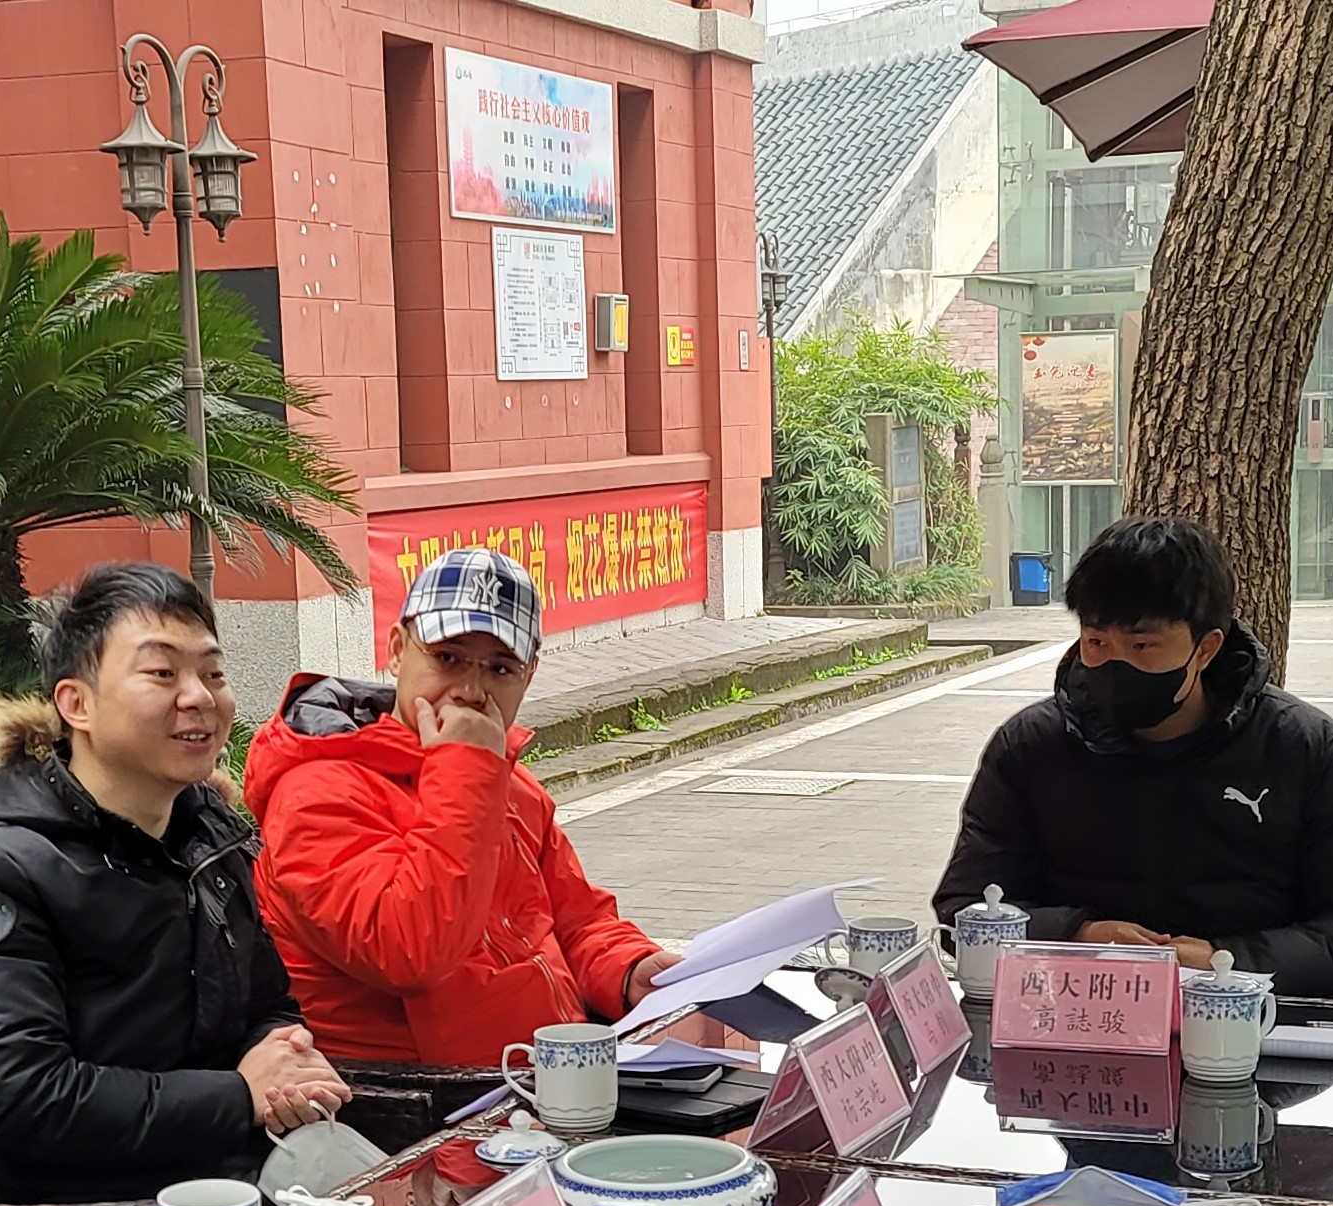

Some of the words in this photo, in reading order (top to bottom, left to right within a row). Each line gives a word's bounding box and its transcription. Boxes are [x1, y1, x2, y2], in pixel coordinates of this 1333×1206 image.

[478, 88, 590, 133] 践行社会主义核心价值观
[504, 153, 516, 168] 自由
[397, 503, 692, 611] 文尚，烟花爆竹禁燃放！
[469, 571, 504, 609] NY
[1021, 970, 1151, 1003] 西大附中
[818, 1037, 880, 1094] 西大附中
